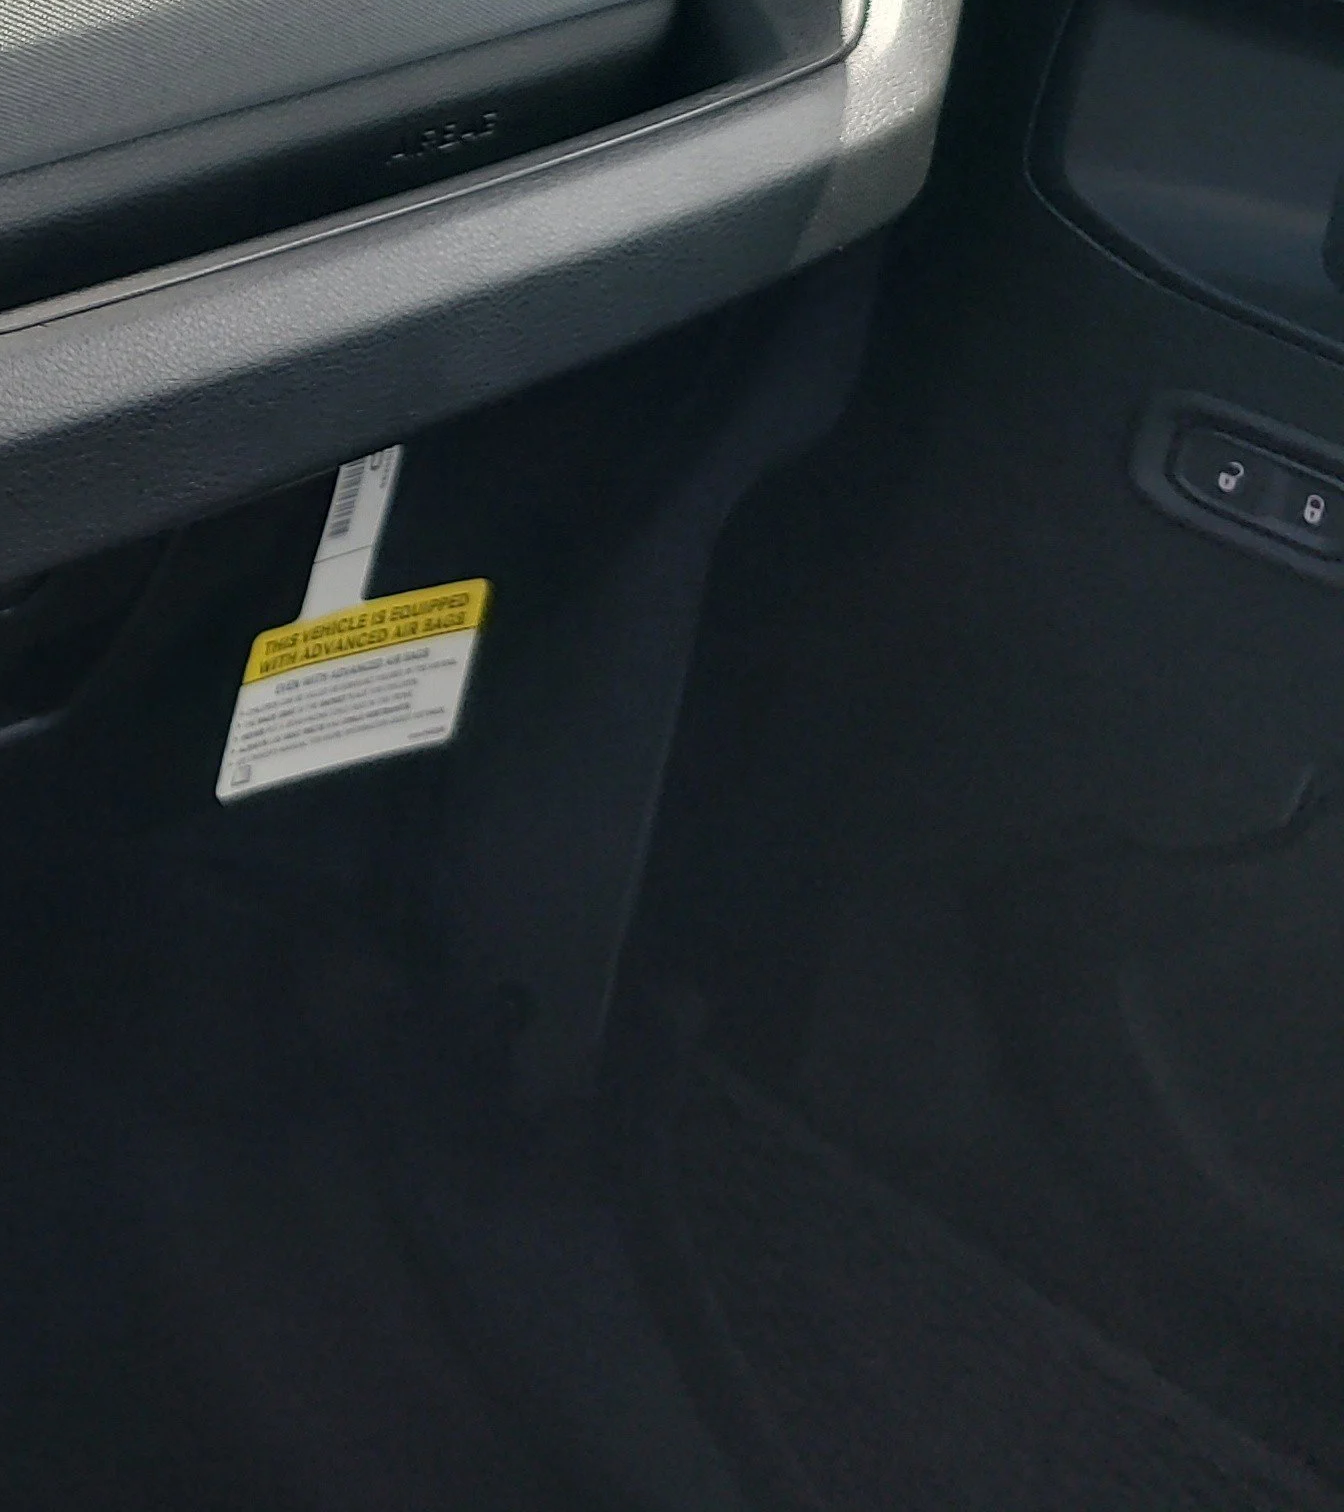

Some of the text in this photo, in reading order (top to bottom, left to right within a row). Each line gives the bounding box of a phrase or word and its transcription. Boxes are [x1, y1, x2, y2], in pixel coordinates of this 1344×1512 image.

[302, 613, 368, 645] VEHICLE
[370, 609, 388, 626] IS
[388, 592, 471, 622] EQUIPPED
[259, 651, 298, 675] WITH
[300, 630, 389, 661] ADVANCED
[392, 620, 419, 639] AIR
